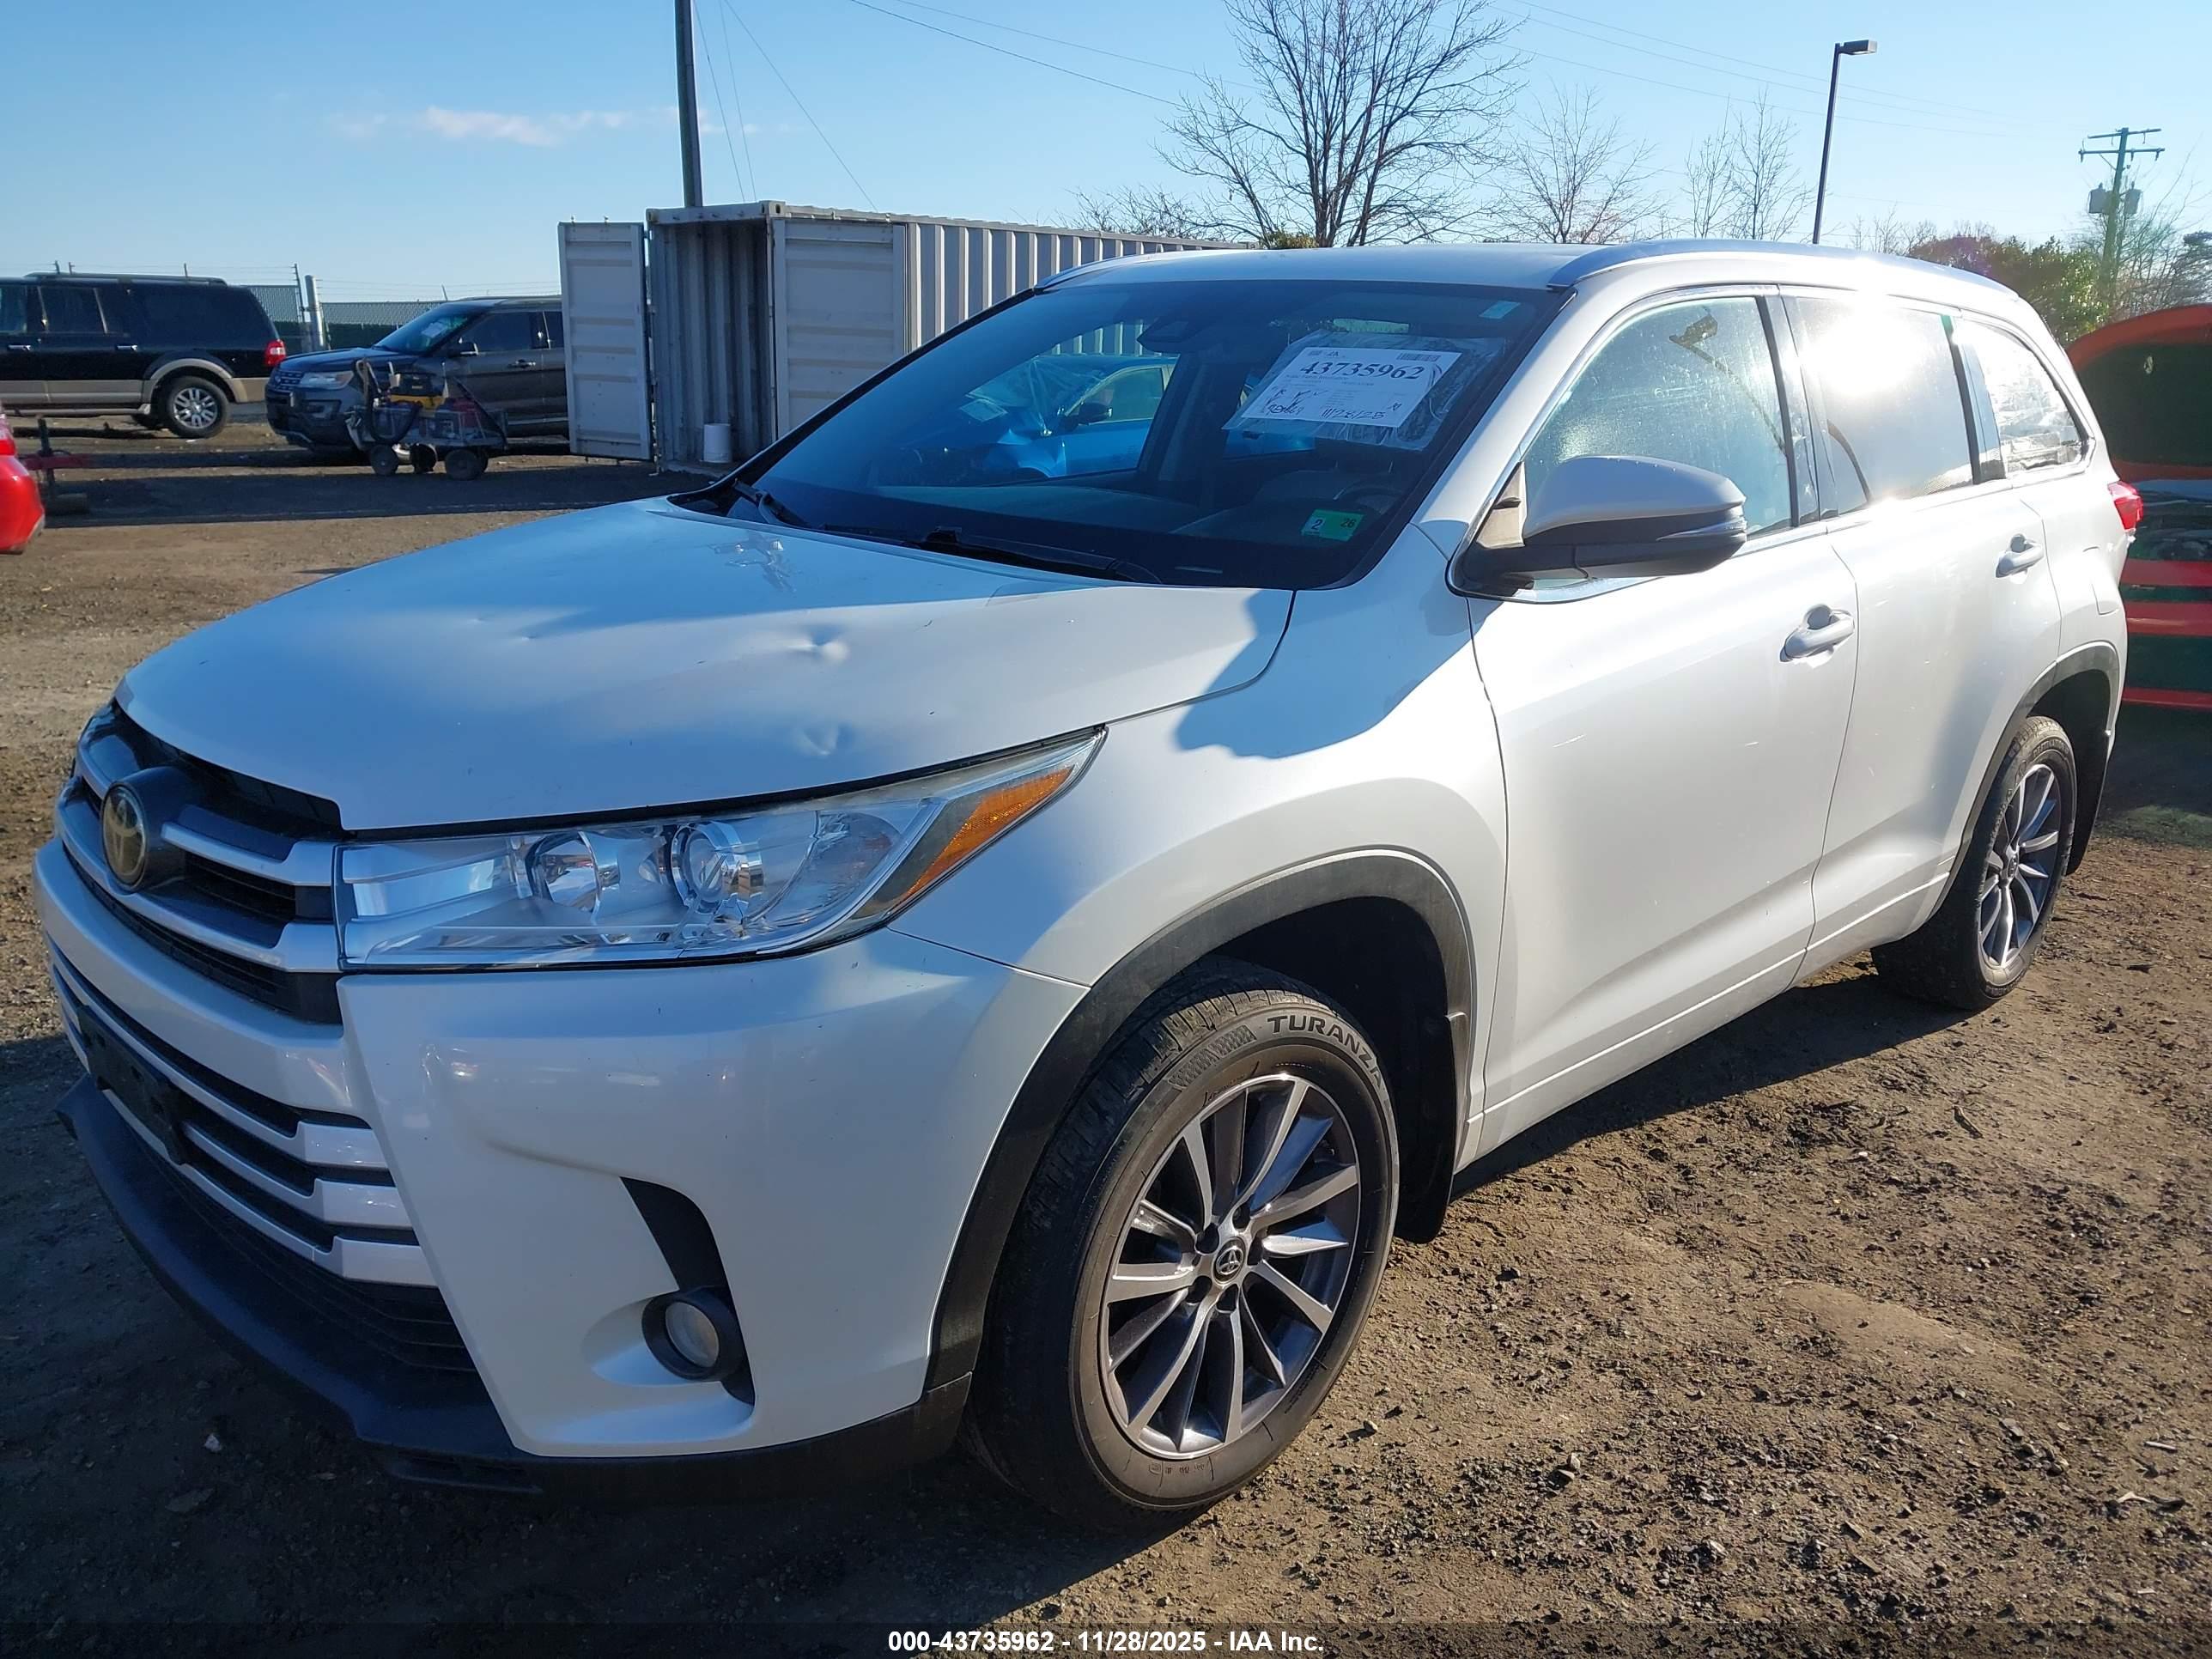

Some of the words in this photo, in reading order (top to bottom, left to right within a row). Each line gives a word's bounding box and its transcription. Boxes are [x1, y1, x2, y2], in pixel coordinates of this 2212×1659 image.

[1300, 361, 1425, 380] 43735962
[1310, 519, 1323, 531] 2
[1267, 1014, 1382, 1090] TURANZA
